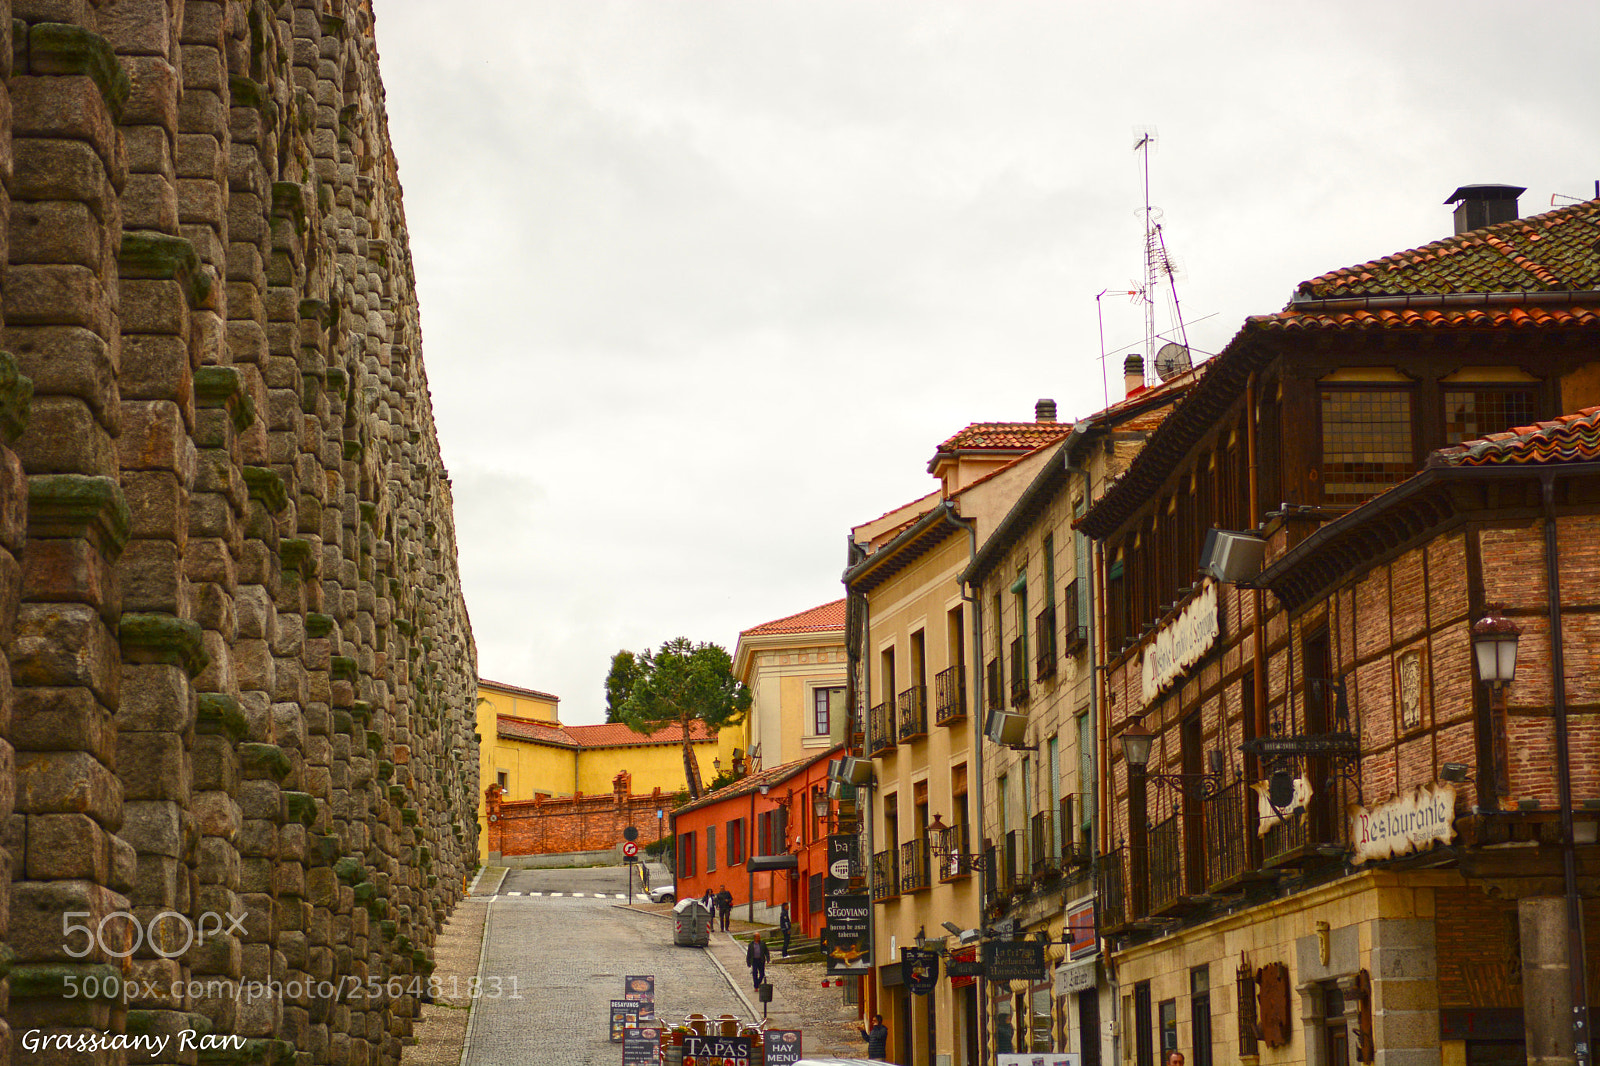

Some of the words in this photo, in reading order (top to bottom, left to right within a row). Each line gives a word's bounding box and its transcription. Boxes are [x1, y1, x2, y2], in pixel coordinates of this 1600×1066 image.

[1360, 797, 1445, 843] Restaurante
[835, 840, 848, 852] ba
[827, 907, 869, 917] SEGOVIANO
[684, 1037, 748, 1057] TAPAS
[772, 1044, 794, 1052] HAY
[767, 1053, 799, 1062] MENÚ
